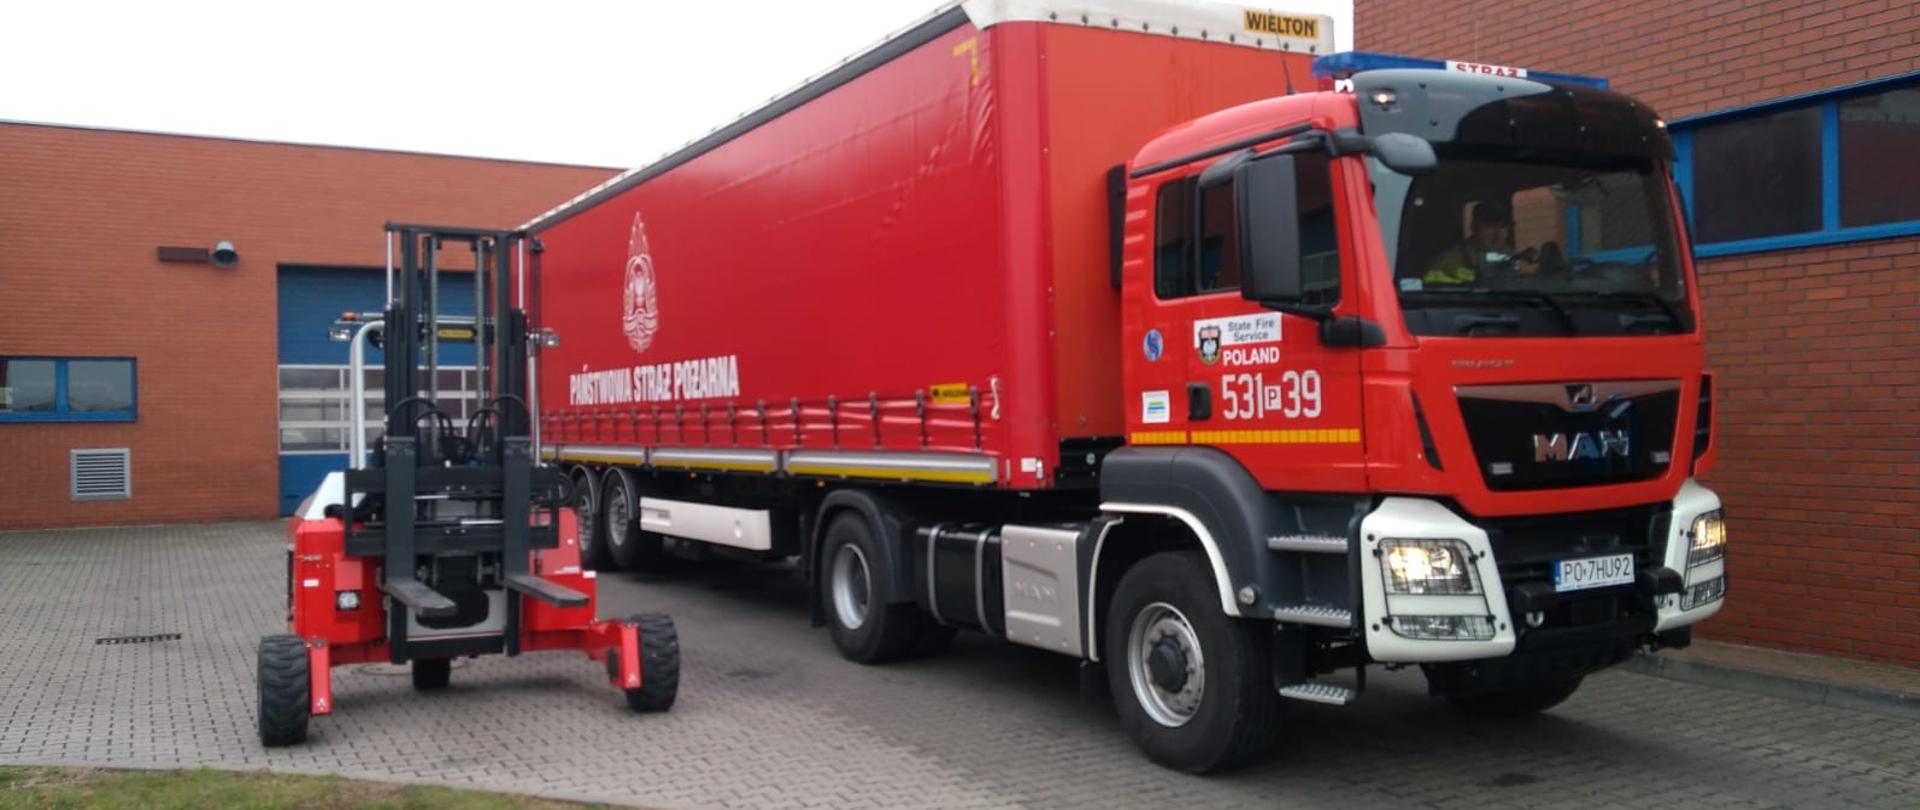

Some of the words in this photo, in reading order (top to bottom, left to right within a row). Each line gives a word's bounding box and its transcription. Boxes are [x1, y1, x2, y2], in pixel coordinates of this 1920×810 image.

[1246, 11, 1315, 37] WIELTON
[1228, 321, 1251, 331] State
[1256, 319, 1275, 328] Fire
[1234, 331, 1269, 341] Service
[1223, 347, 1280, 366] POLAND
[570, 364, 633, 406] PAŃSTWOWA
[1534, 429, 1630, 462] MAN
